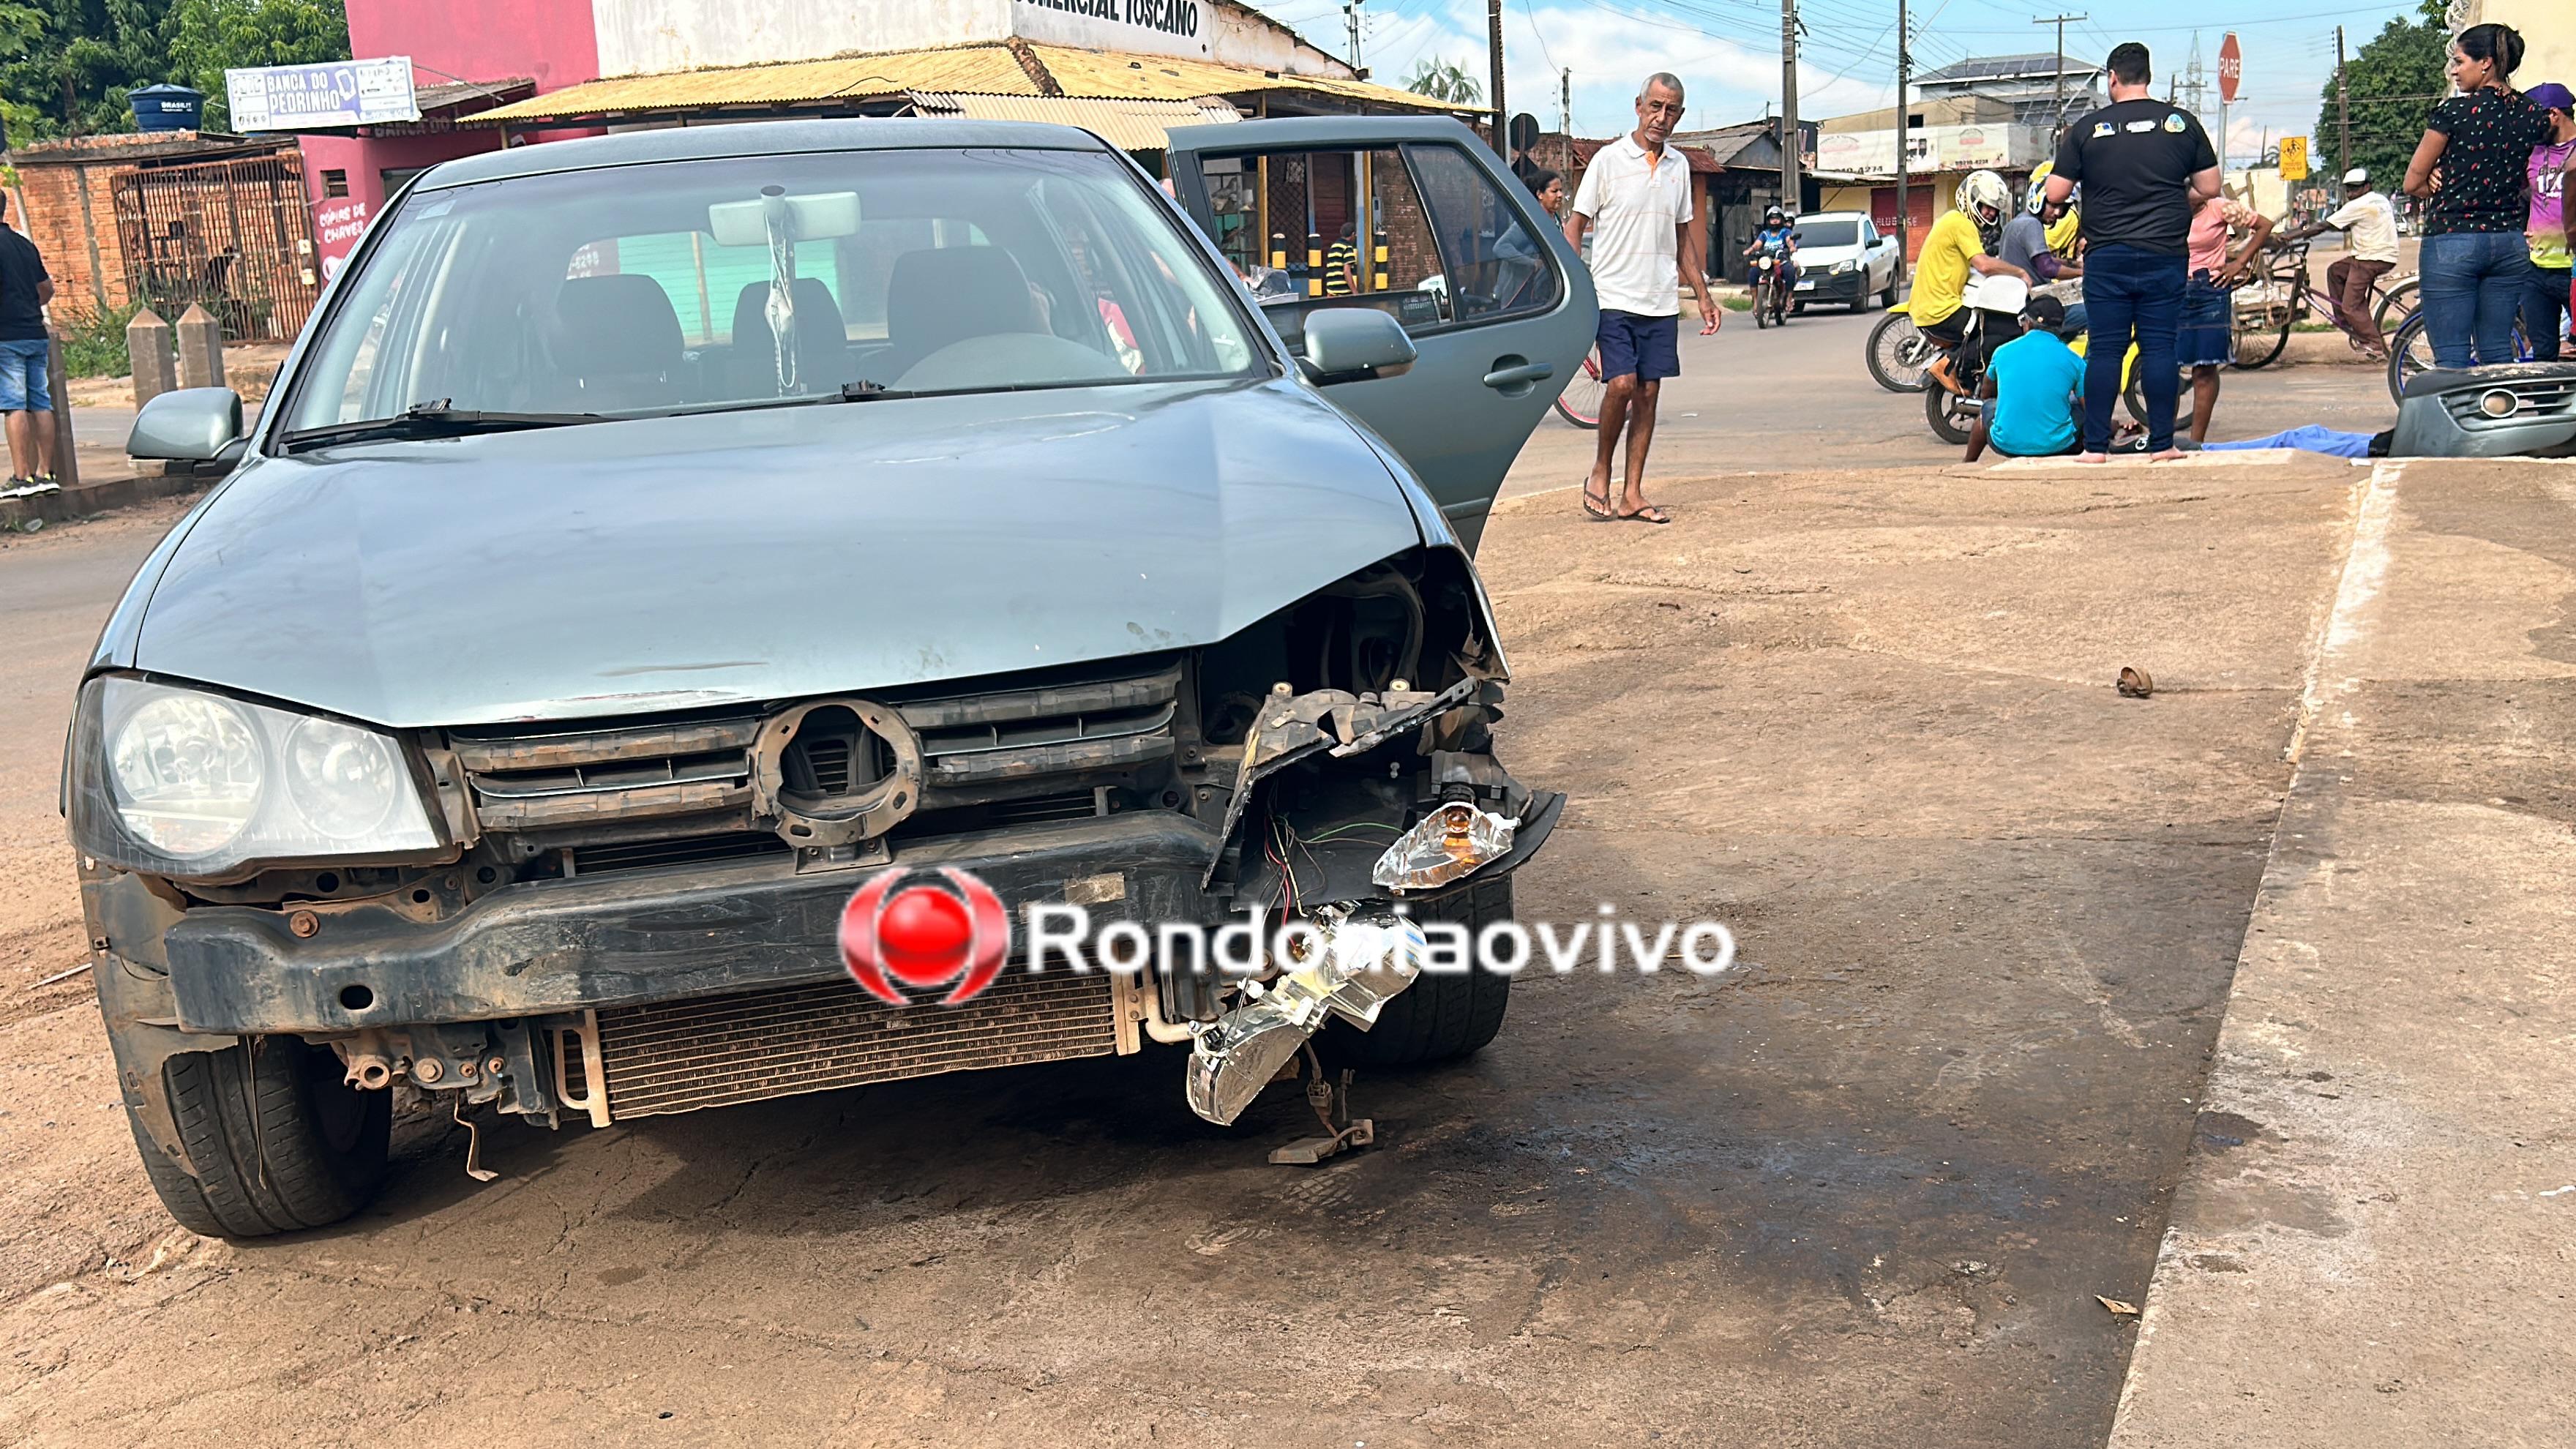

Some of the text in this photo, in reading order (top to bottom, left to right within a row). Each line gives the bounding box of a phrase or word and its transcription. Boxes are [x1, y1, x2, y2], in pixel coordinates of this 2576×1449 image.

[1125, 0, 1197, 37] TOSCANO
[2219, 57, 2239, 78] PARE
[266, 71, 329, 93] BANCA DO
[269, 89, 341, 113] PEDRINHO
[353, 202, 365, 218] DE
[324, 220, 364, 244] CHAVES
